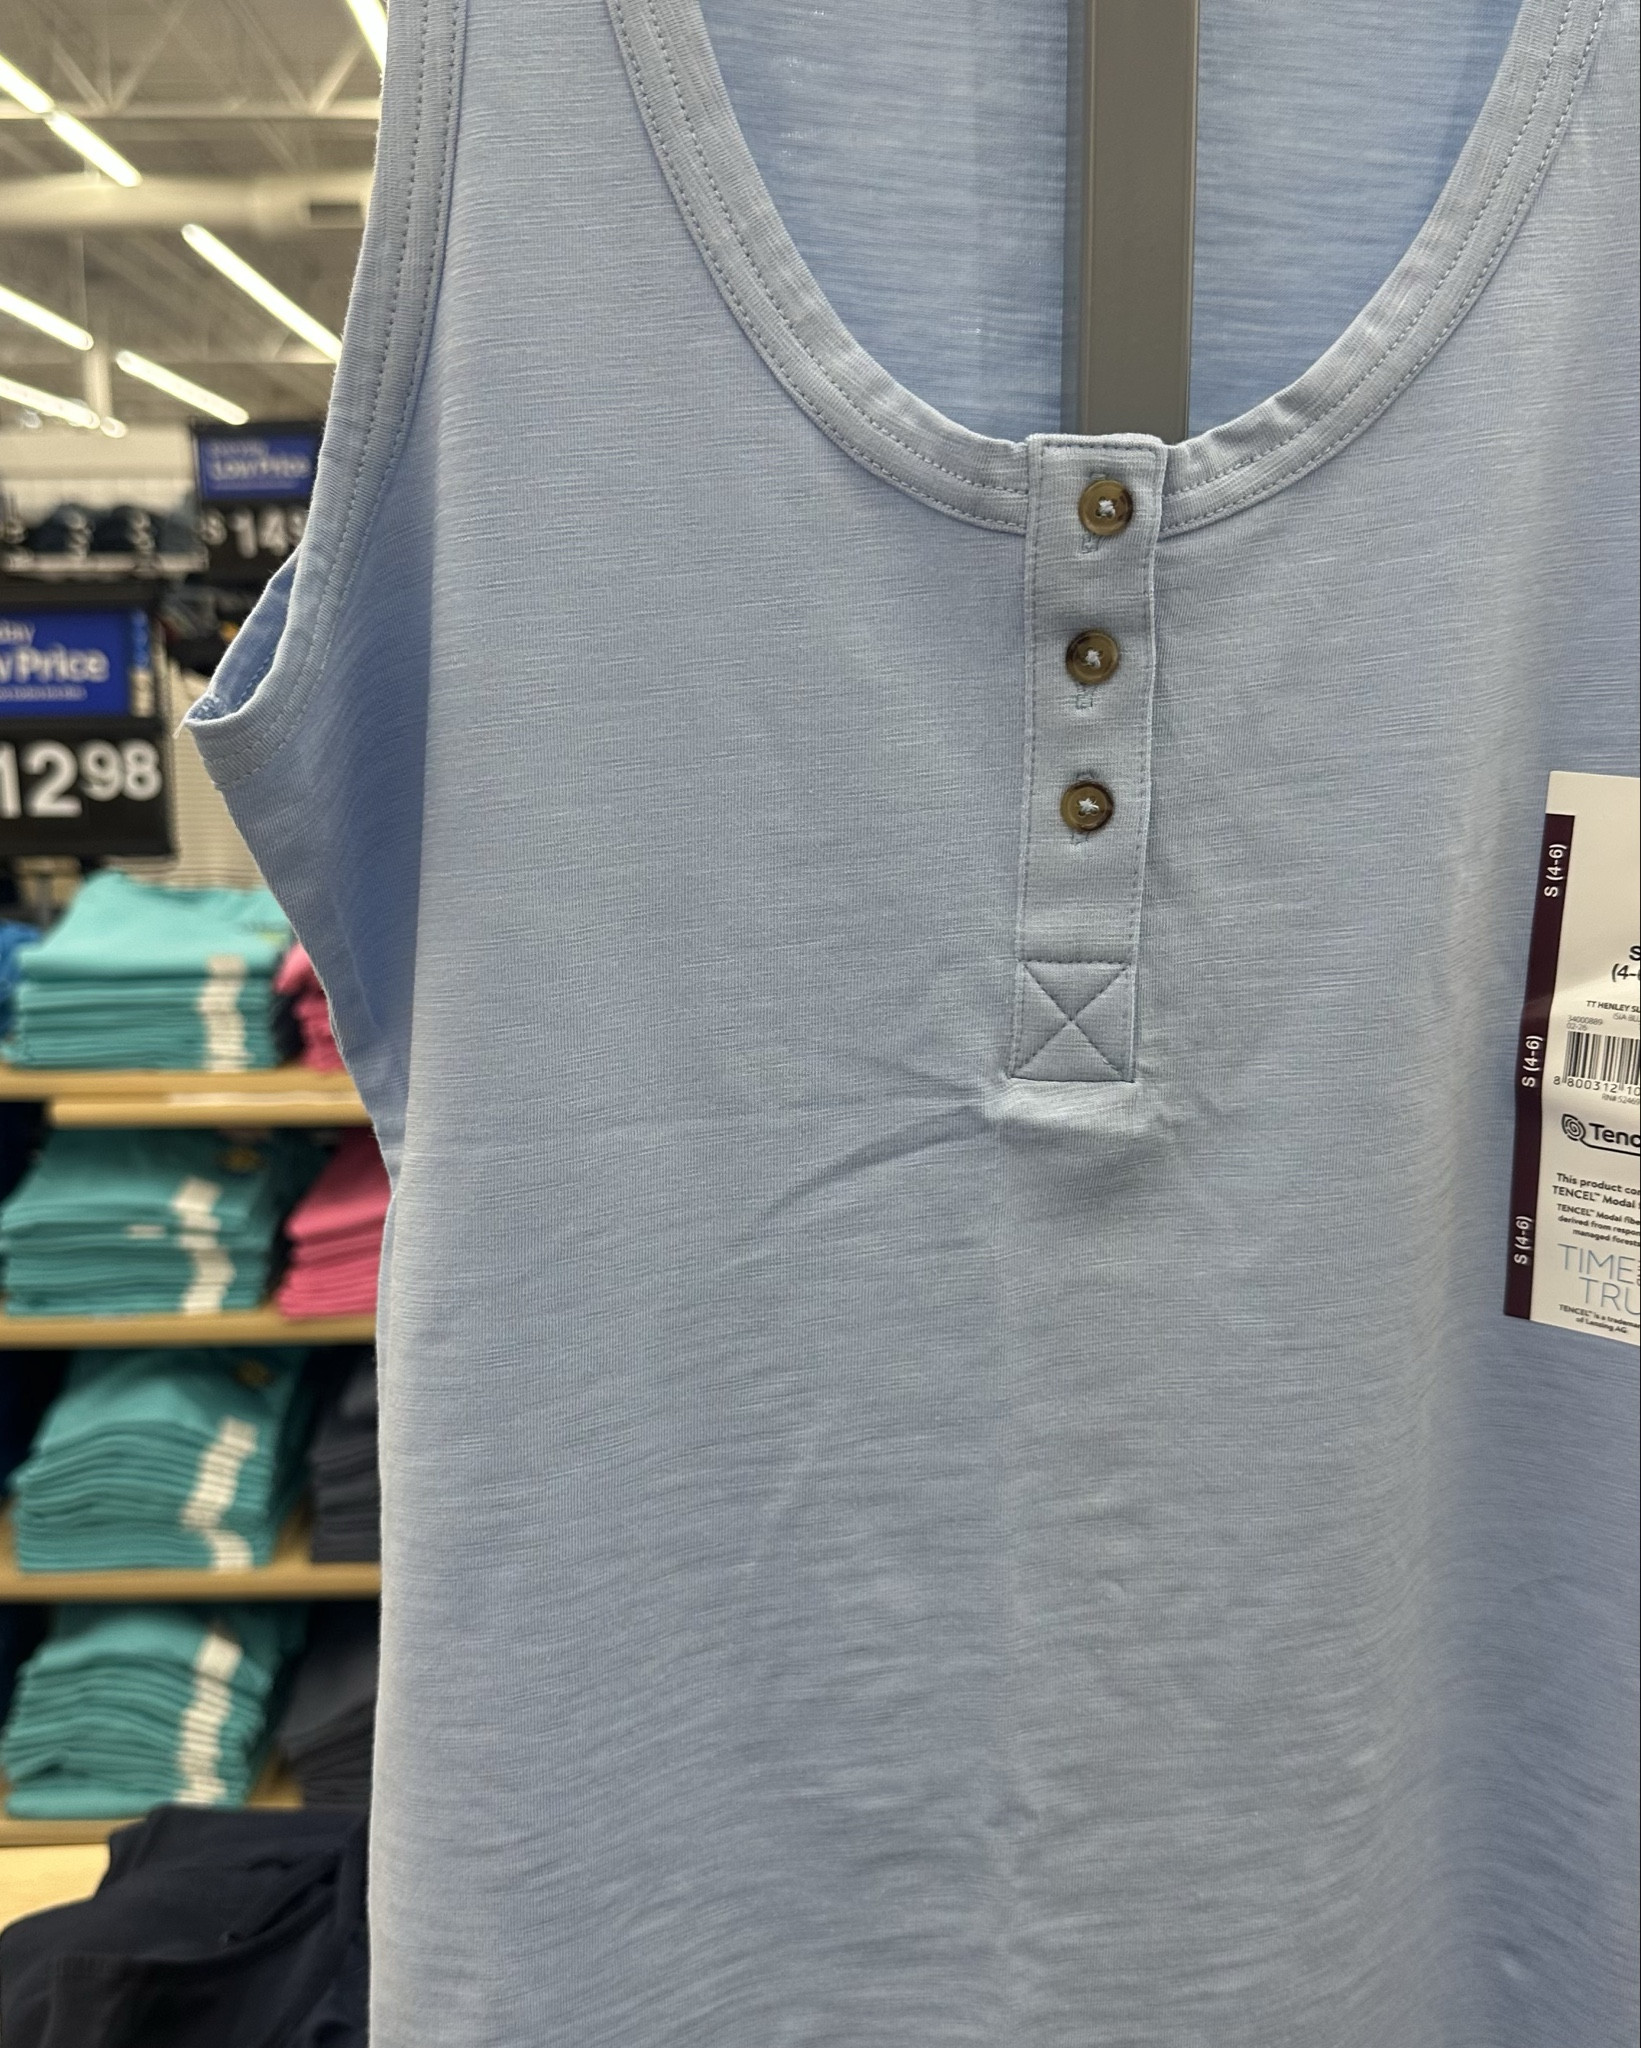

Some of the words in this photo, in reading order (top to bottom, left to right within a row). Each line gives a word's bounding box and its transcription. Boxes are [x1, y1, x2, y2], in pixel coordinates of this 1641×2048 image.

[15, 643, 110, 684] Price
[1545, 843, 1568, 881] (4-6)
[1544, 886, 1559, 898] S
[1612, 963, 1640, 982] (4-
[1586, 1000, 1597, 1009] TT
[1597, 1001, 1630, 1012] HENLEY
[1523, 1035, 1544, 1072] (4-6)
[1522, 1076, 1536, 1088] S
[1553, 1075, 1561, 1086] 8
[1567, 1077, 1618, 1094] 800312
[1556, 1172, 1577, 1185] This
[1580, 1180, 1622, 1193] product
[1602, 1195, 1636, 1209] Modal
[1558, 1215, 1589, 1227] derived
[1591, 1221, 1611, 1231] from
[1596, 1211, 1622, 1222] Modal
[1515, 1215, 1534, 1250] (4-6)
[1573, 1229, 1610, 1241] managed
[1513, 1253, 1528, 1265] S
[1557, 1243, 1636, 1284] TIME
